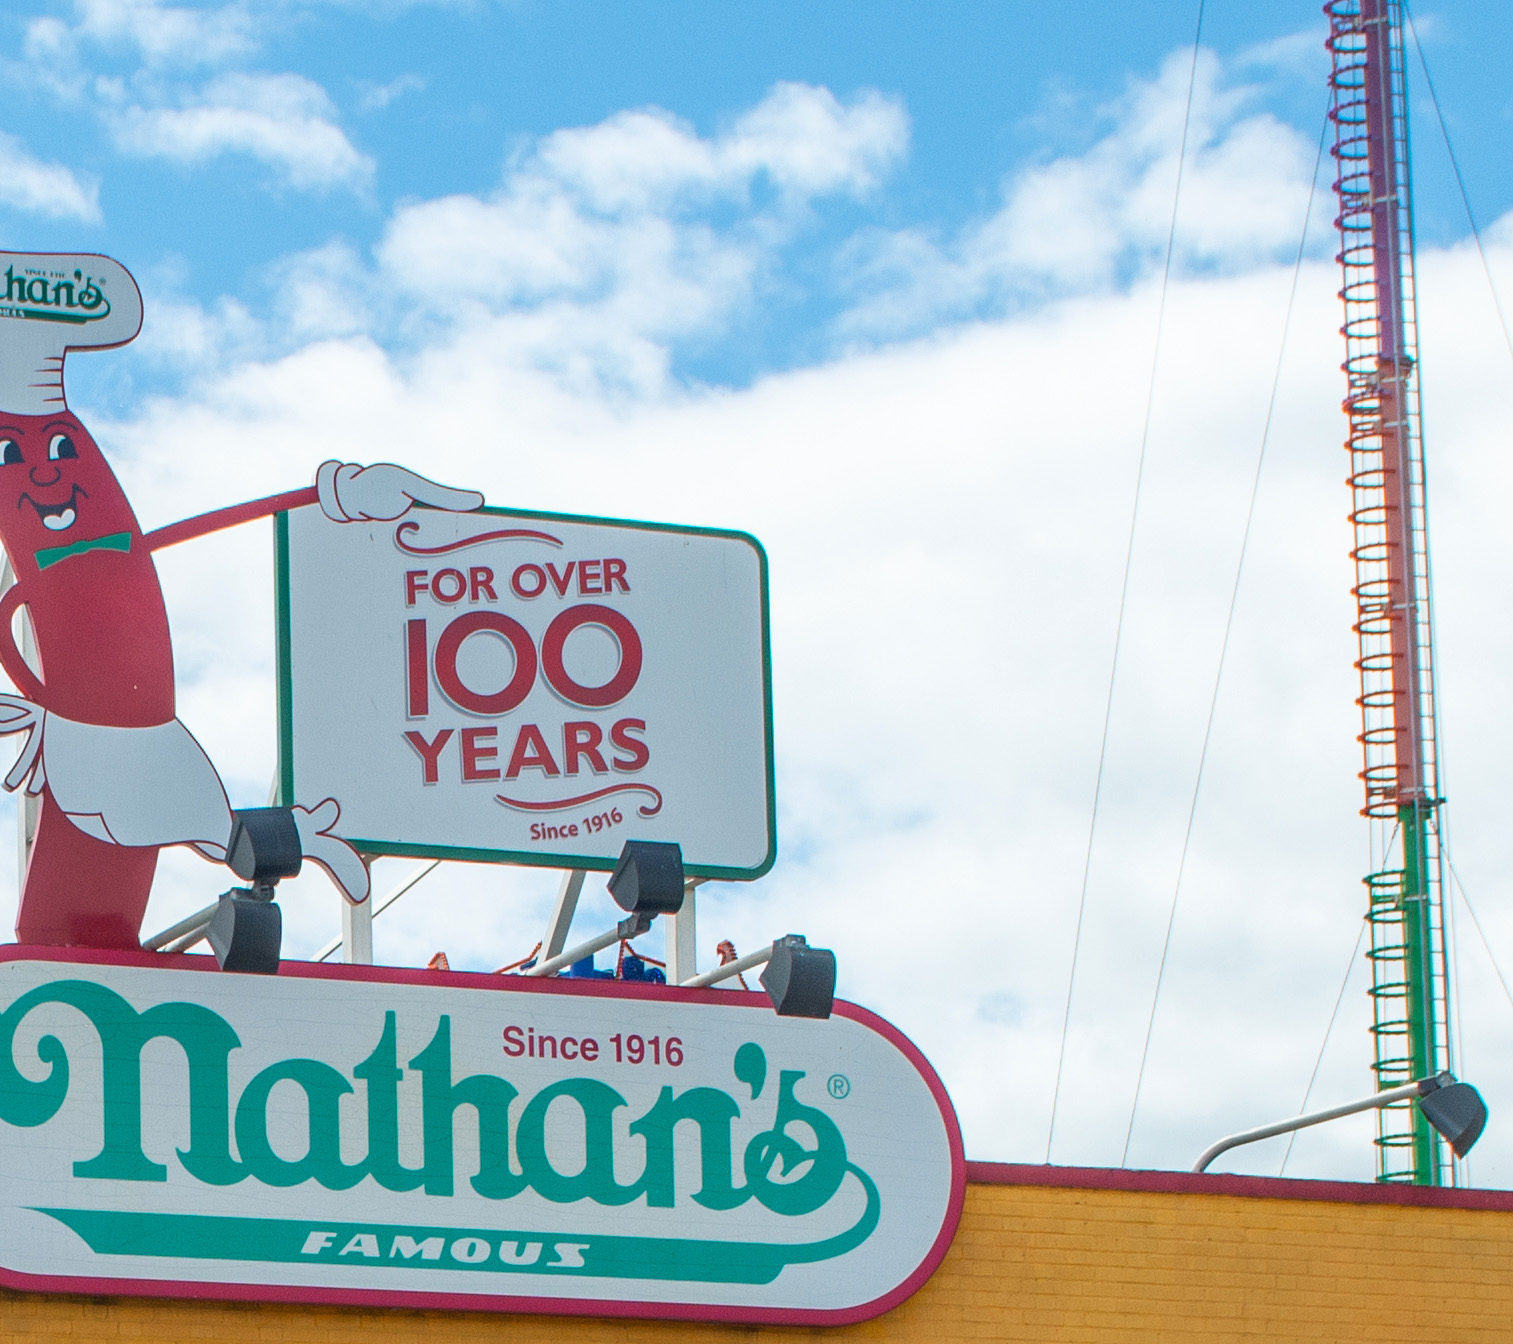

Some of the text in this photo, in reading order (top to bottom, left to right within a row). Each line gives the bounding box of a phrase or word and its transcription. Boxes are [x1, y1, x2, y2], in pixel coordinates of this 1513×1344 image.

[406, 558, 631, 606] FOR OVER
[405, 718, 651, 784] YEARS
[530, 807, 624, 840] Since 1916
[501, 1023, 684, 1068] Since 1916
[300, 1228, 591, 1270] FAMOUS
